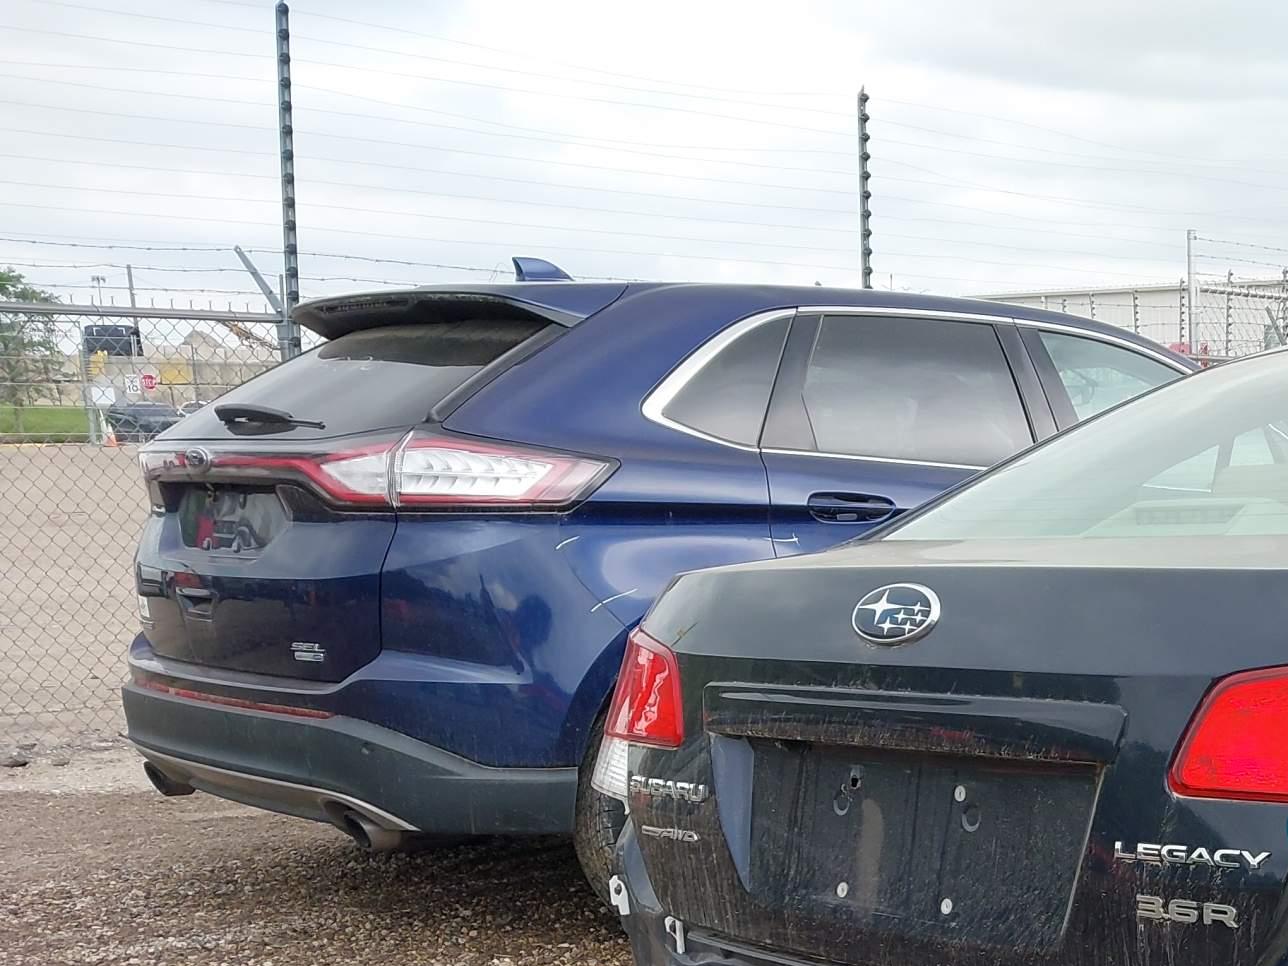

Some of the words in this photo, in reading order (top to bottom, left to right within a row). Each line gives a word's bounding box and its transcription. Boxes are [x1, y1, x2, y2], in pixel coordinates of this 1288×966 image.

[629, 775, 708, 802] SUBARU
[1114, 841, 1272, 868] LEGACY
[1136, 894, 1239, 928] 3.6R
